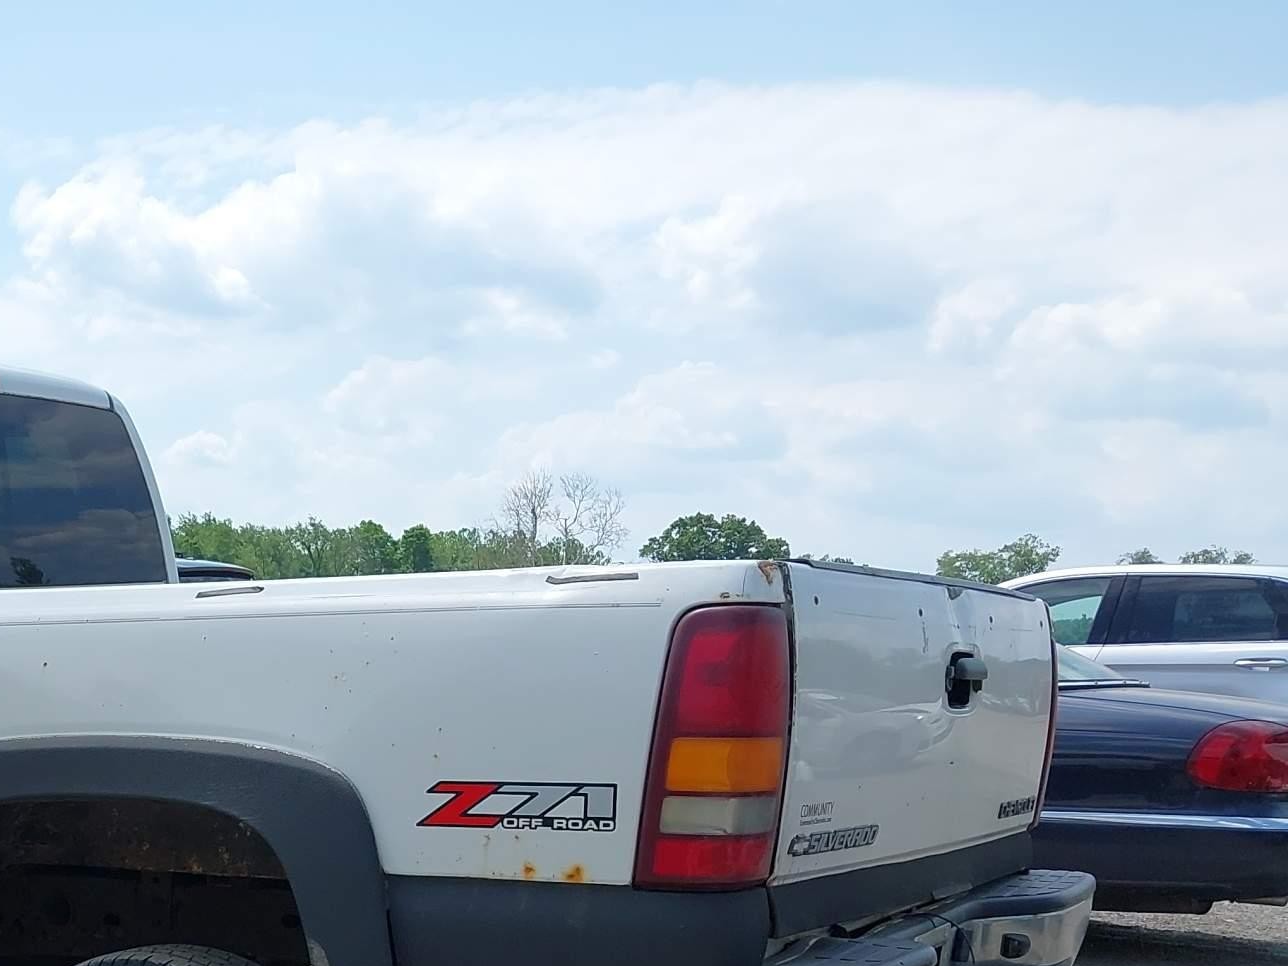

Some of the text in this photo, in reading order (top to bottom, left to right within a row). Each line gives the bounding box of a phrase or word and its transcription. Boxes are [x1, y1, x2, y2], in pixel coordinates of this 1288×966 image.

[416, 781, 617, 828] Z71
[503, 817, 615, 831] OFF ROAD
[808, 826, 878, 852] SILVERADO
